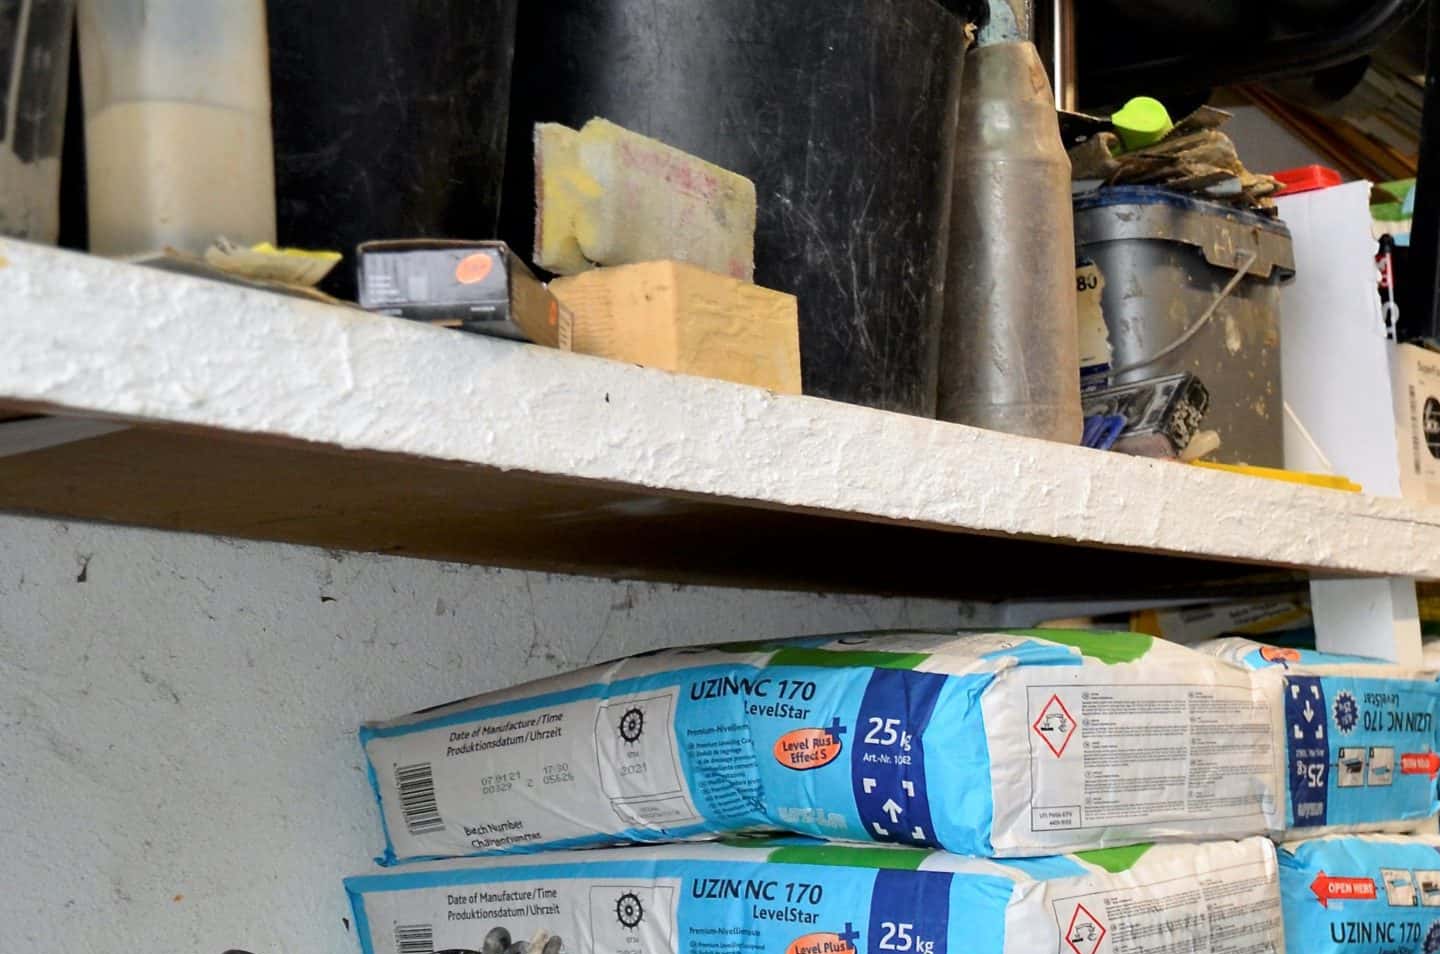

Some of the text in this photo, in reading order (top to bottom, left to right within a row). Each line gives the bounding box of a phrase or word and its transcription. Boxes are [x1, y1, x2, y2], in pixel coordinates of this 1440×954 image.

[690, 674, 817, 701] UZIN NC 170
[744, 700, 811, 720] LevelStar
[1363, 710, 1383, 731] 170
[863, 717, 901, 746] 25
[1387, 711, 1403, 732] NC
[1405, 712, 1433, 734] UZIN
[449, 729, 469, 743] Date
[471, 726, 481, 738] of
[782, 739, 810, 752] Level
[790, 749, 828, 765] Effect S
[1308, 764, 1325, 787] 25
[692, 878, 823, 905] UZIN NC 170
[1328, 881, 1351, 894] OPEN
[447, 894, 467, 906] Date
[468, 892, 478, 904] of
[752, 904, 820, 925] LevelStar
[878, 921, 914, 951] 25
[1330, 921, 1373, 945] UZIN
[1375, 921, 1395, 944] NC
[1399, 921, 1422, 945] 170
[823, 940, 847, 954] Plus
